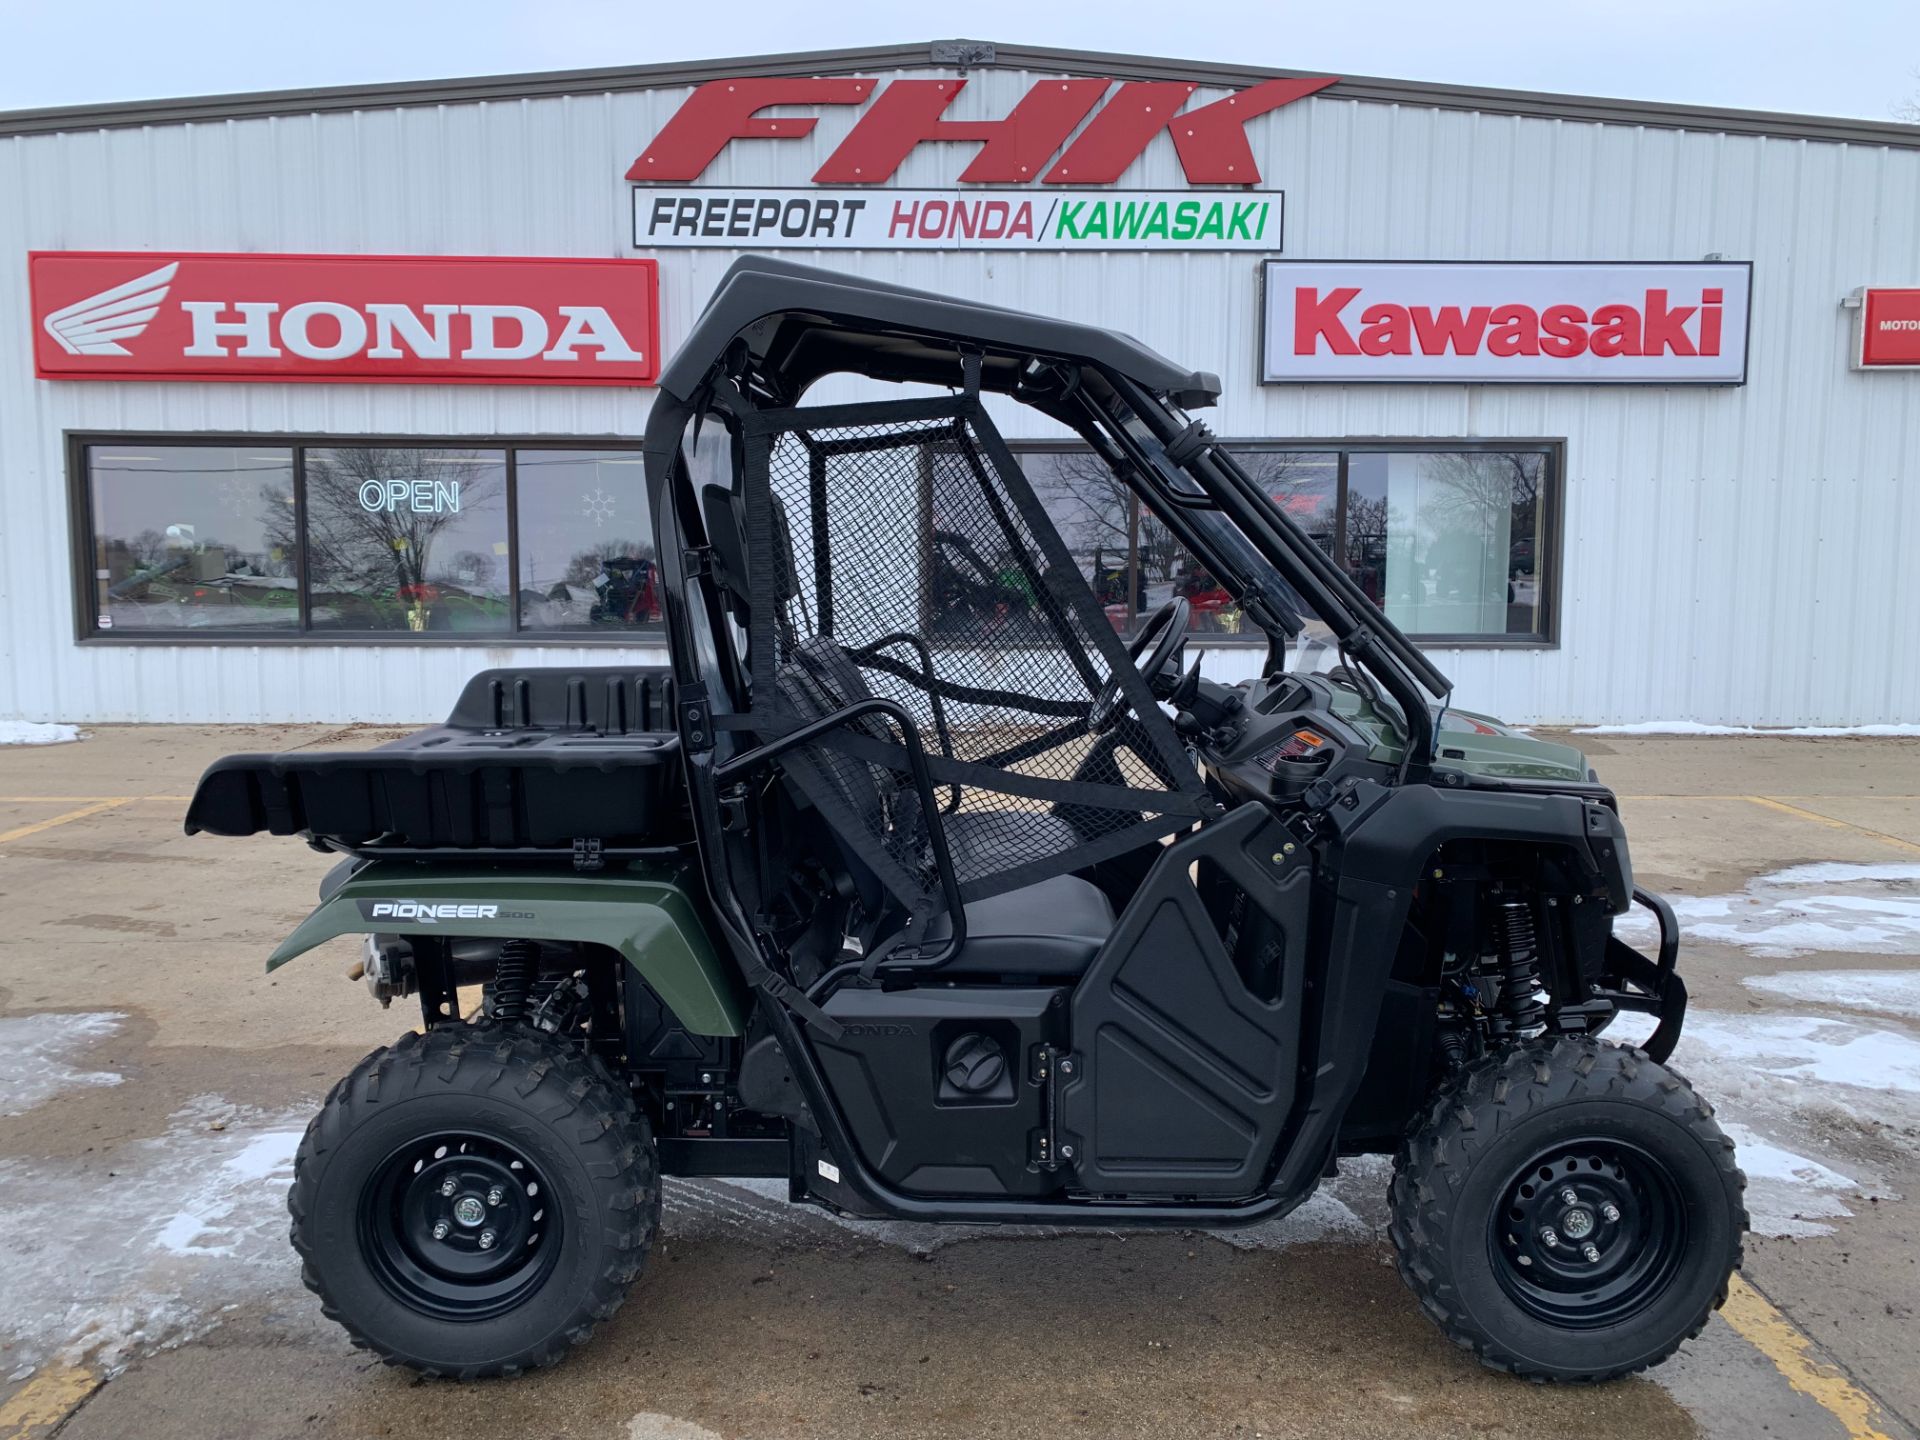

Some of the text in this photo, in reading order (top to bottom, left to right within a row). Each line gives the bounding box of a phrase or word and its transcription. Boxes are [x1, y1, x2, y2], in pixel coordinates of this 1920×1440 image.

[625, 77, 1341, 184] FHK
[648, 197, 866, 239] FREEPORT
[181, 301, 643, 362] HONDA
[1294, 287, 1723, 359] Kawasaki
[359, 479, 459, 513] OPEN
[372, 903, 498, 919] PIONEER
[839, 1023, 918, 1037] ONDA
